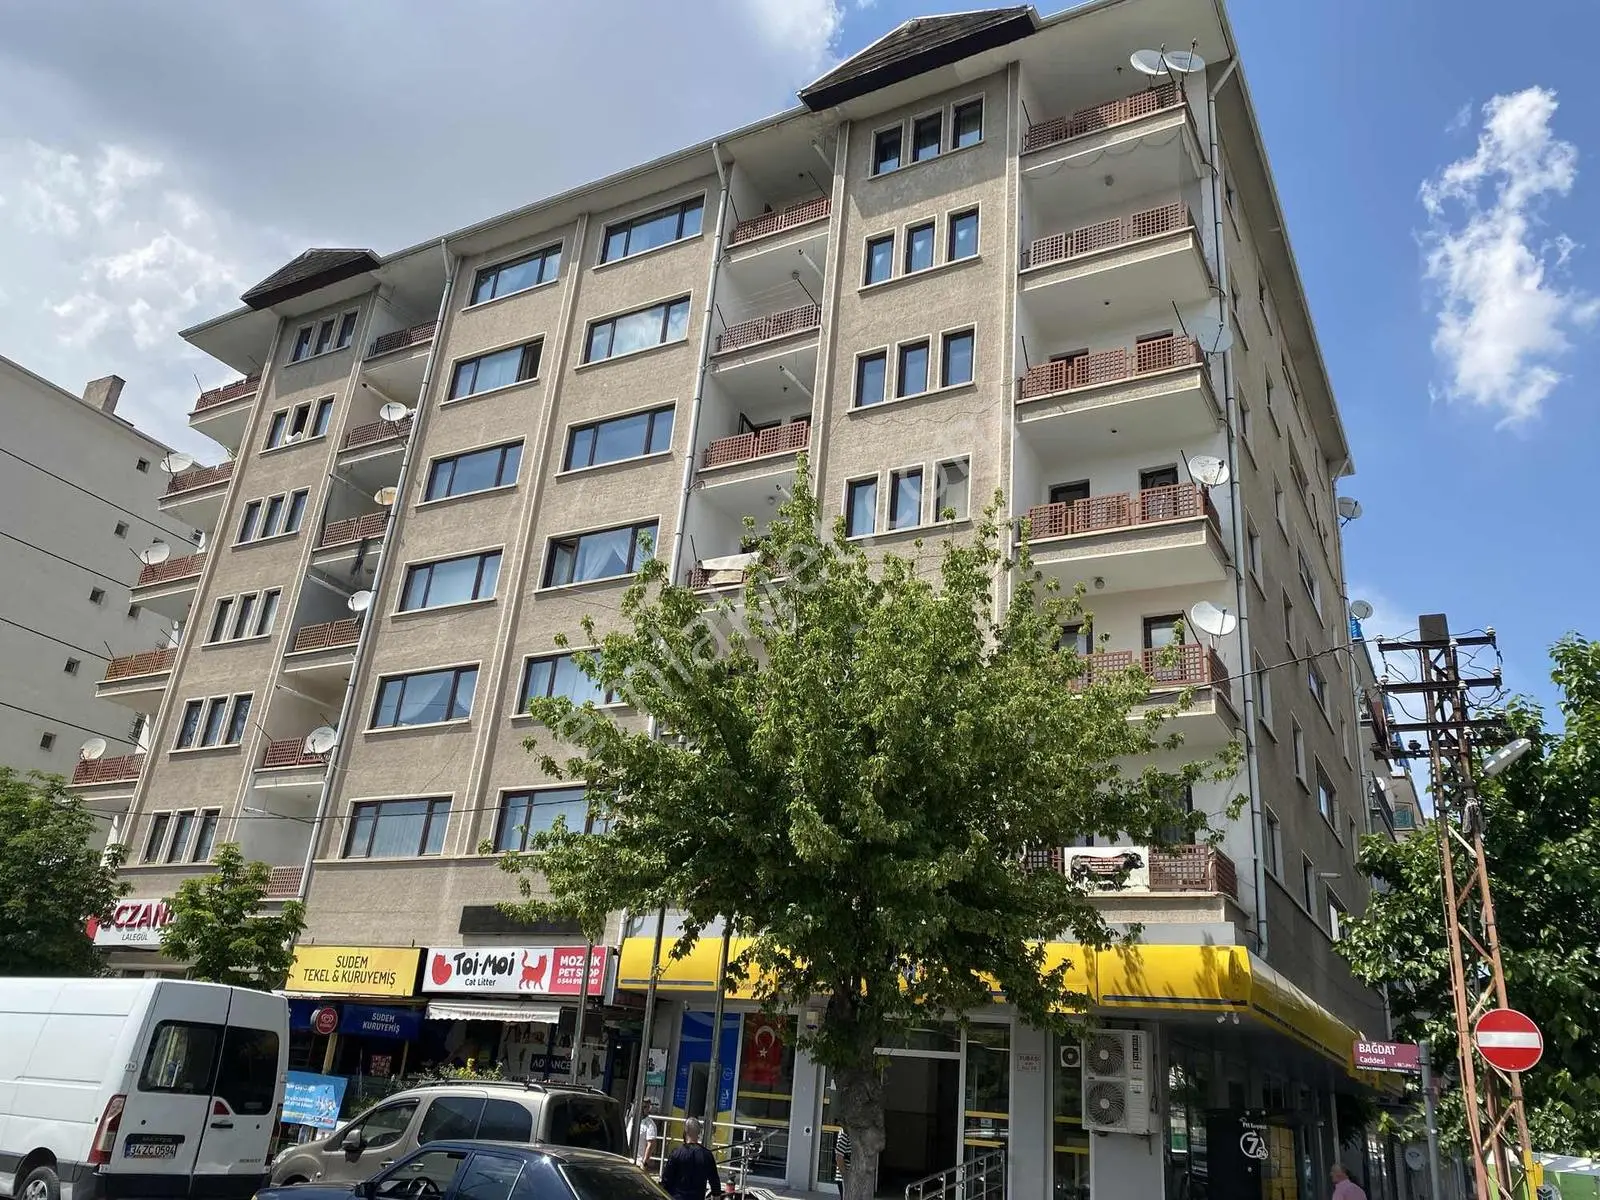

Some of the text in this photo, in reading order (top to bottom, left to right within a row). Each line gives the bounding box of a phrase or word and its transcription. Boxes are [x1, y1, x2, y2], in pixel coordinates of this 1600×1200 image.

[121, 933, 148, 941] LALEGÜL
[335, 955, 369, 969] SUDEM
[558, 968, 576, 977] PET
[303, 968, 397, 989] TEKEL & KURUYEMİŞ
[464, 977, 497, 987] Cat Litter
[371, 1012, 396, 1023] SUDEM
[361, 1020, 402, 1035] KURUYEMİŞ
[1358, 1042, 1397, 1056] BAĞDAT
[531, 1059, 572, 1070] ADANCE
[1359, 1056, 1386, 1065] Caddesi
[130, 1145, 175, 1156] 34 ZC 0594
[1246, 1137, 1259, 1154] 7
